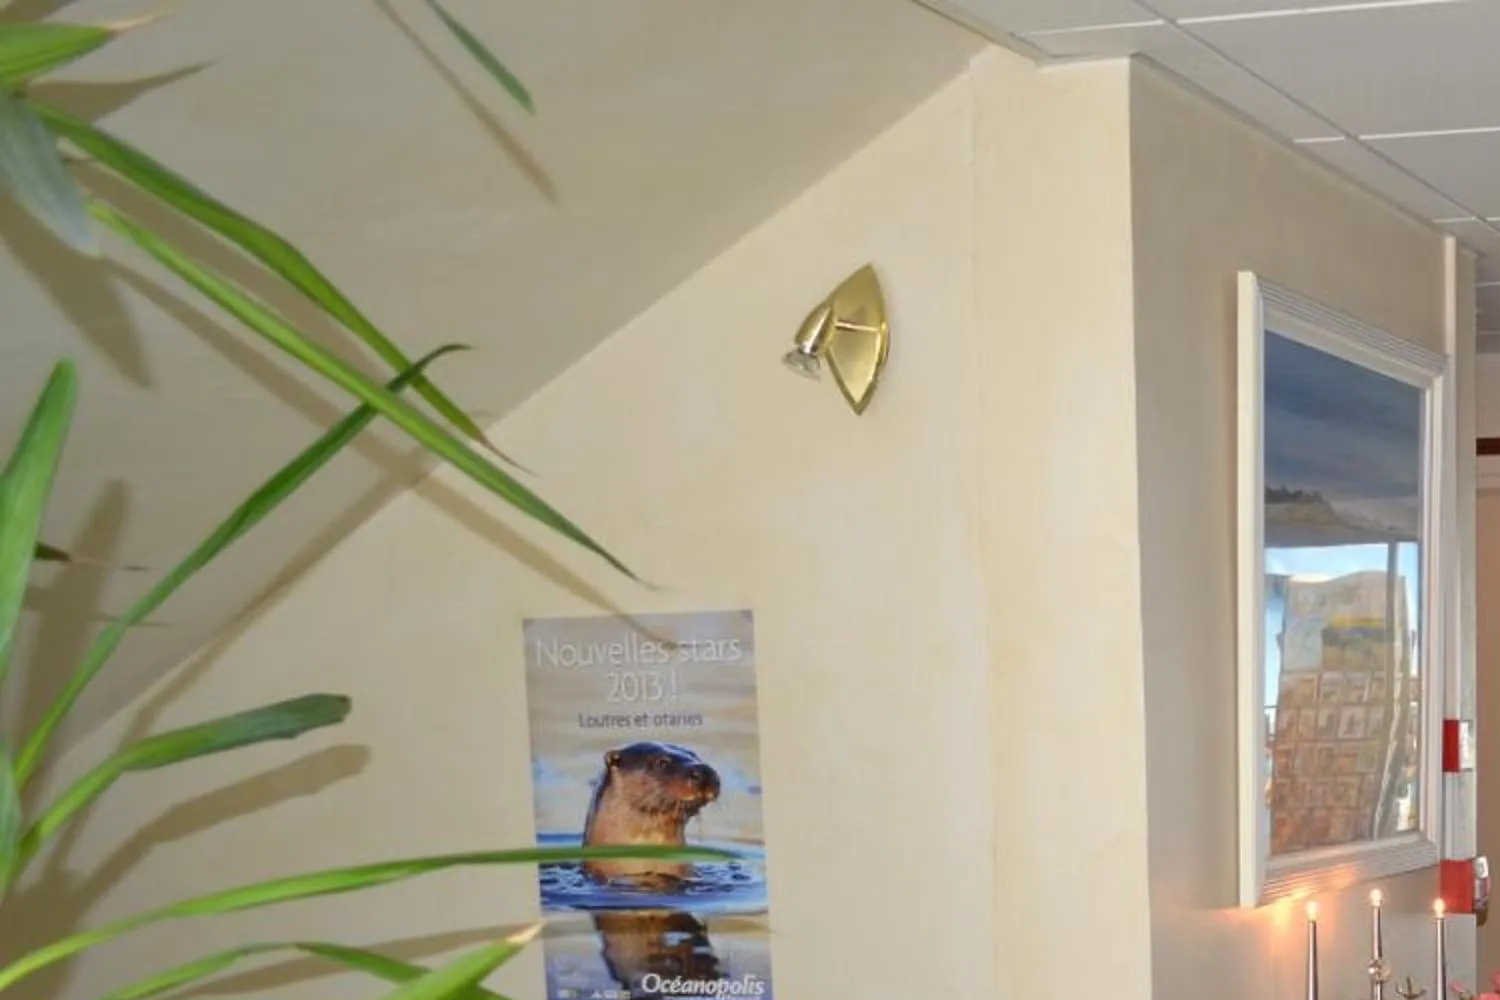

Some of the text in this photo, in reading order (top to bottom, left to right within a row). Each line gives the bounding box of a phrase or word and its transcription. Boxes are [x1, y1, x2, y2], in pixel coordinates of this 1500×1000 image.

[536, 633, 743, 667] Nouvelles stars
[606, 673, 664, 701] 2013
[578, 711, 703, 728] Loutres et otaries
[641, 973, 765, 1000] Océanopolis
